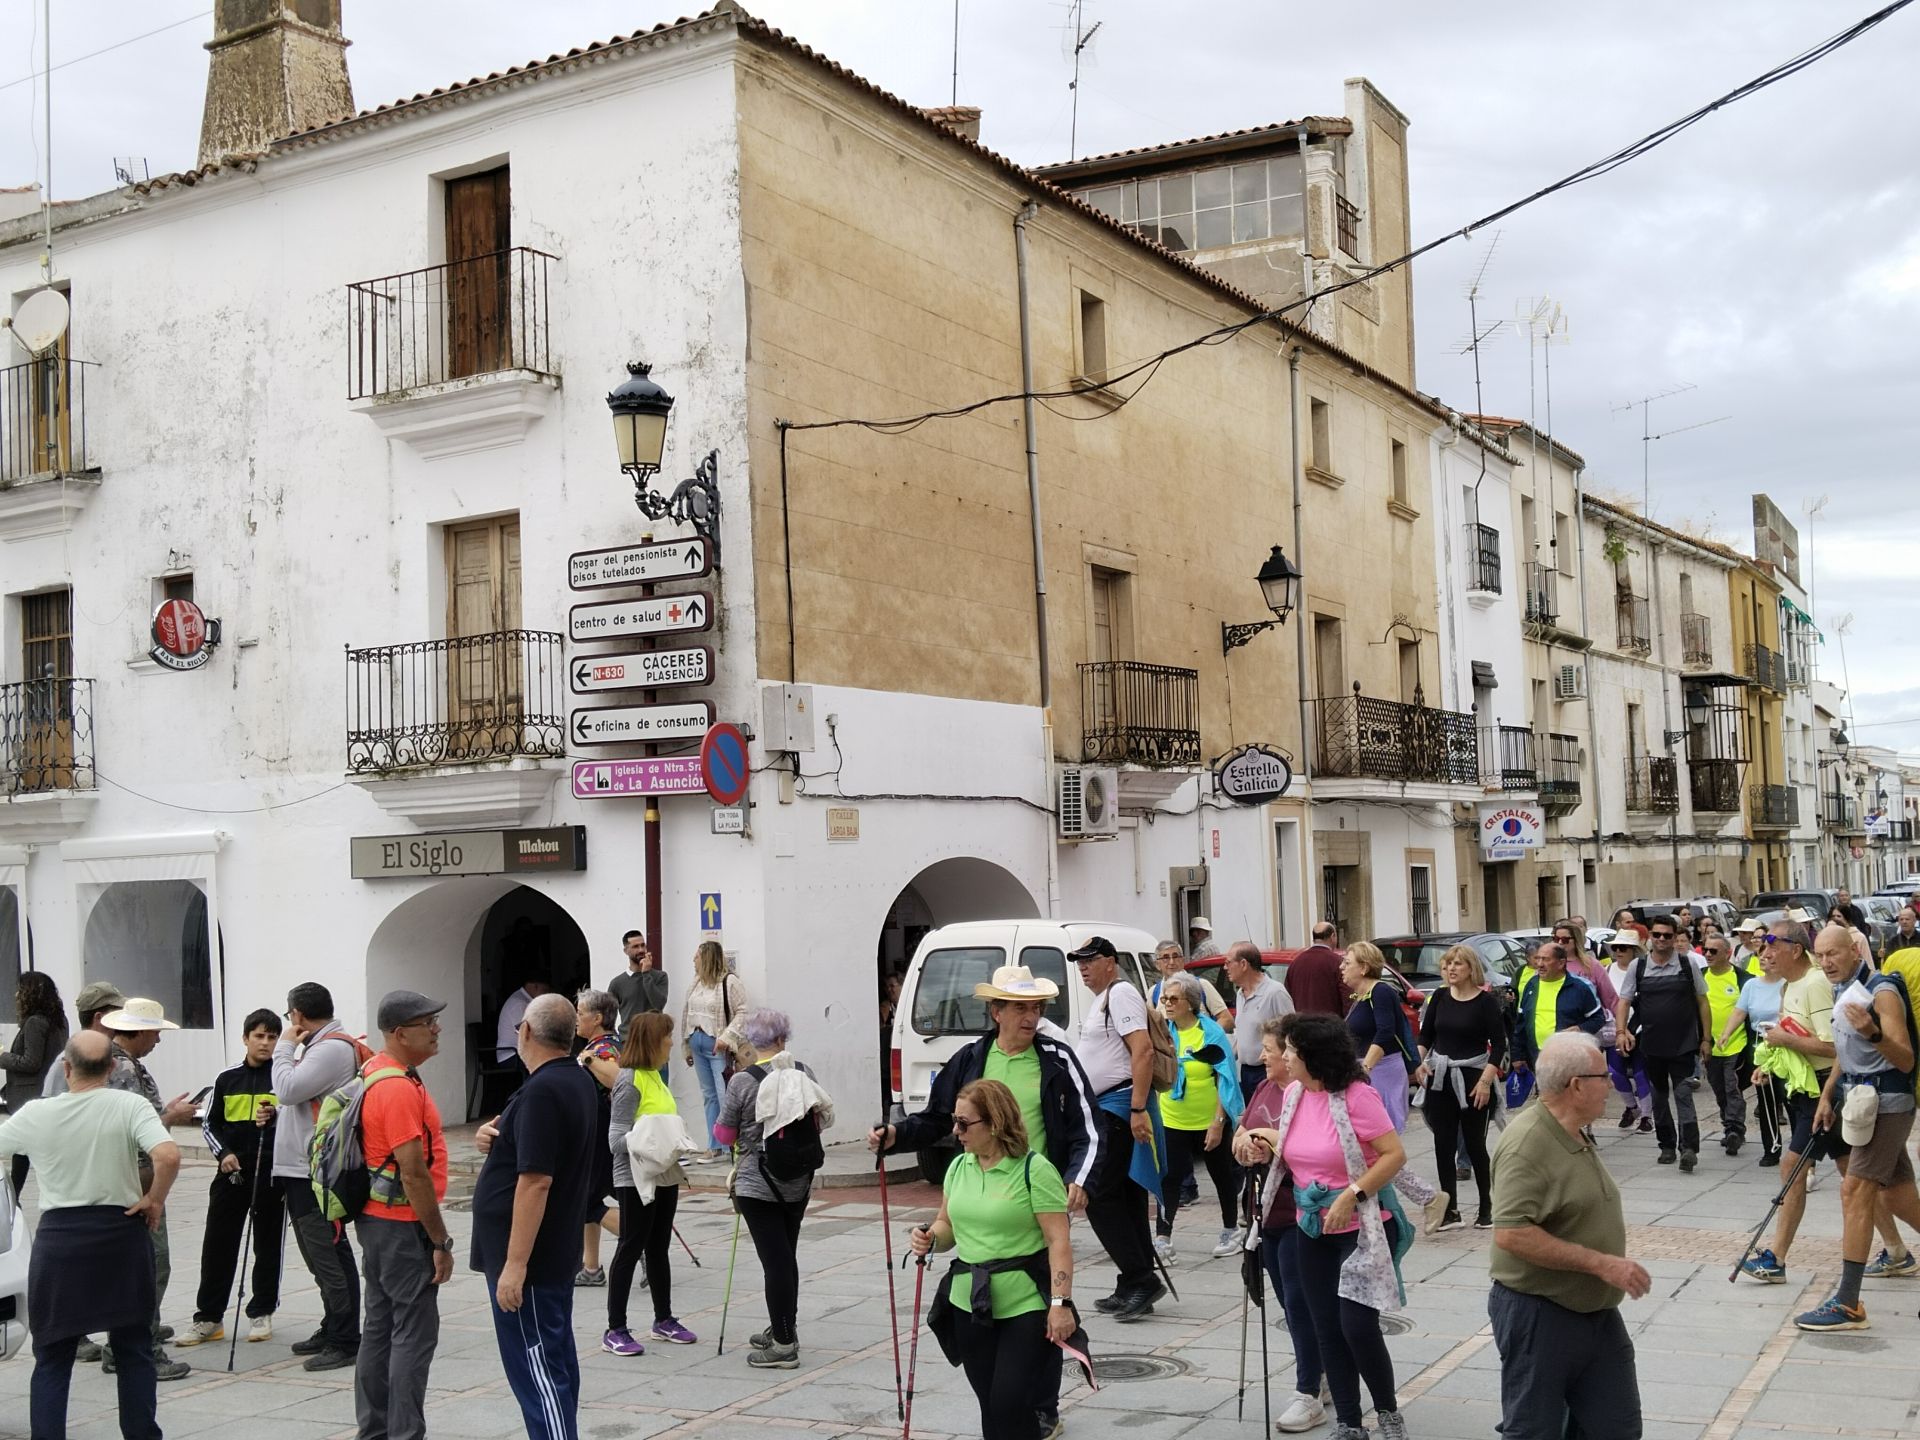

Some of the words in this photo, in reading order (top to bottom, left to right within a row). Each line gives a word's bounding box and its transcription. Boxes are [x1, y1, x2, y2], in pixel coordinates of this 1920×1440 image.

[573, 558, 598, 570] hogar
[604, 554, 618, 565] del
[623, 547, 677, 565] pensionista
[573, 572, 597, 584] pisos
[602, 565, 646, 579] tutelados
[574, 616, 607, 629] centro
[613, 614, 626, 625] de
[632, 610, 661, 623] salud
[160, 650, 174, 664] BAR
[187, 653, 206, 667] SIGLO
[643, 652, 704, 670] CÁCERES
[594, 666, 624, 680] N-630
[646, 667, 704, 682] PLASENCIA
[595, 720, 630, 732] oficina
[638, 718, 650, 730] de
[657, 716, 706, 728] consumo
[615, 765, 643, 777] iglesia
[649, 764, 659, 774] de
[1230, 763, 1280, 779] Estrella
[614, 781, 624, 791] de
[629, 777, 642, 790] La
[1233, 776, 1278, 792] Galicia
[1484, 809, 1540, 830] CRISTALERIA
[518, 840, 559, 854] Mahou
[382, 842, 402, 869] El
[409, 840, 463, 874] Siglo
